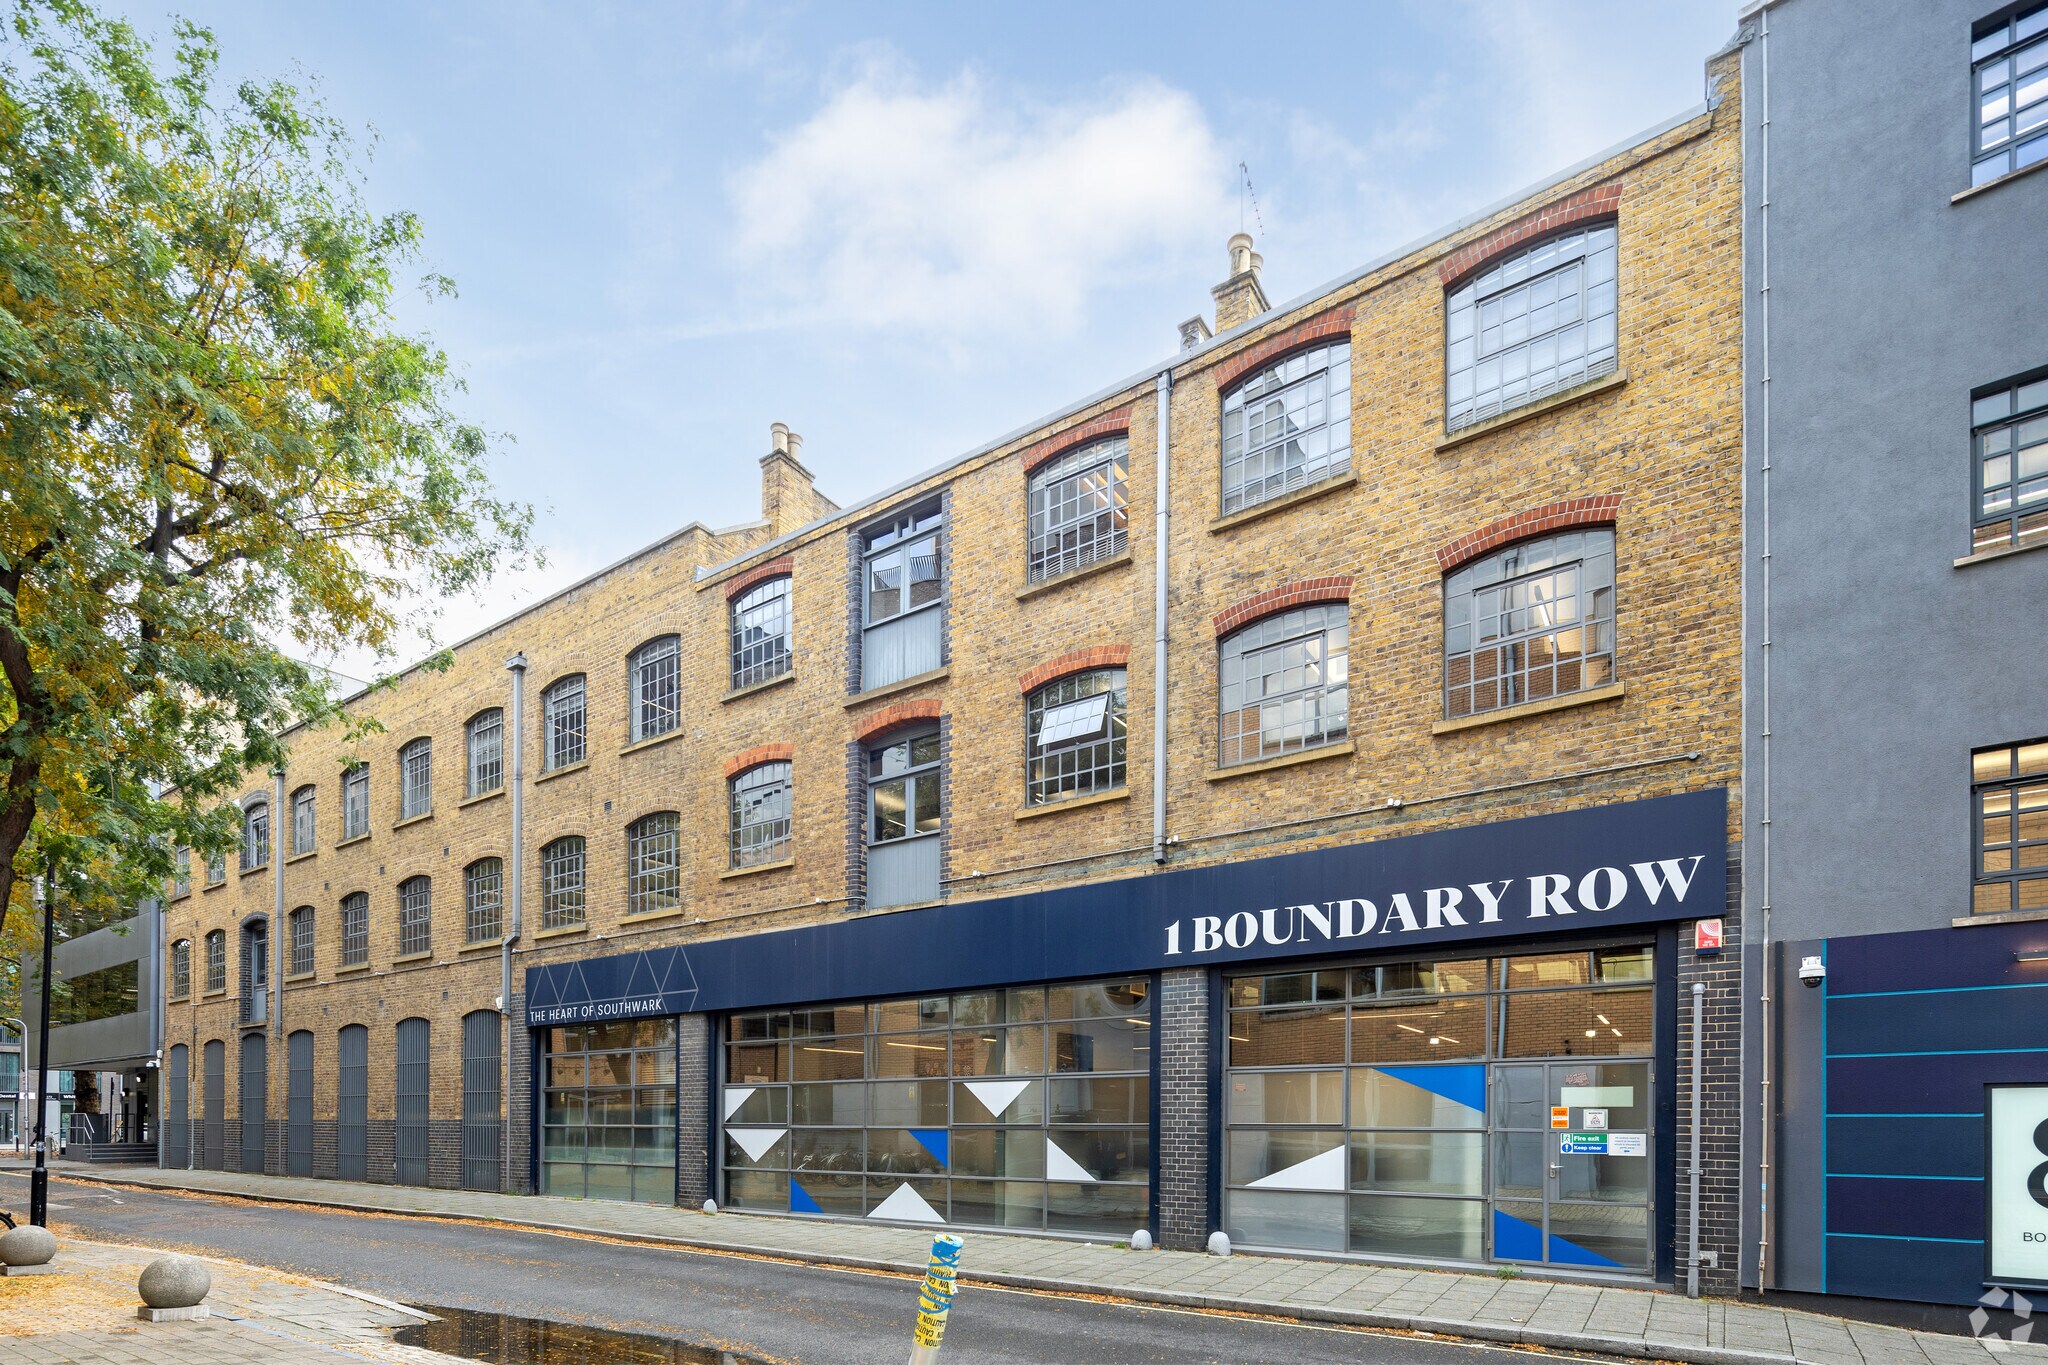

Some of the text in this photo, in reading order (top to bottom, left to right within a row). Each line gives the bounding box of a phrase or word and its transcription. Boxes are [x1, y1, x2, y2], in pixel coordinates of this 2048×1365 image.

[1164, 855, 1706, 955] 1 BOUNDARY ROW
[530, 998, 662, 1022] THE HEART OF SOUTHWARK
